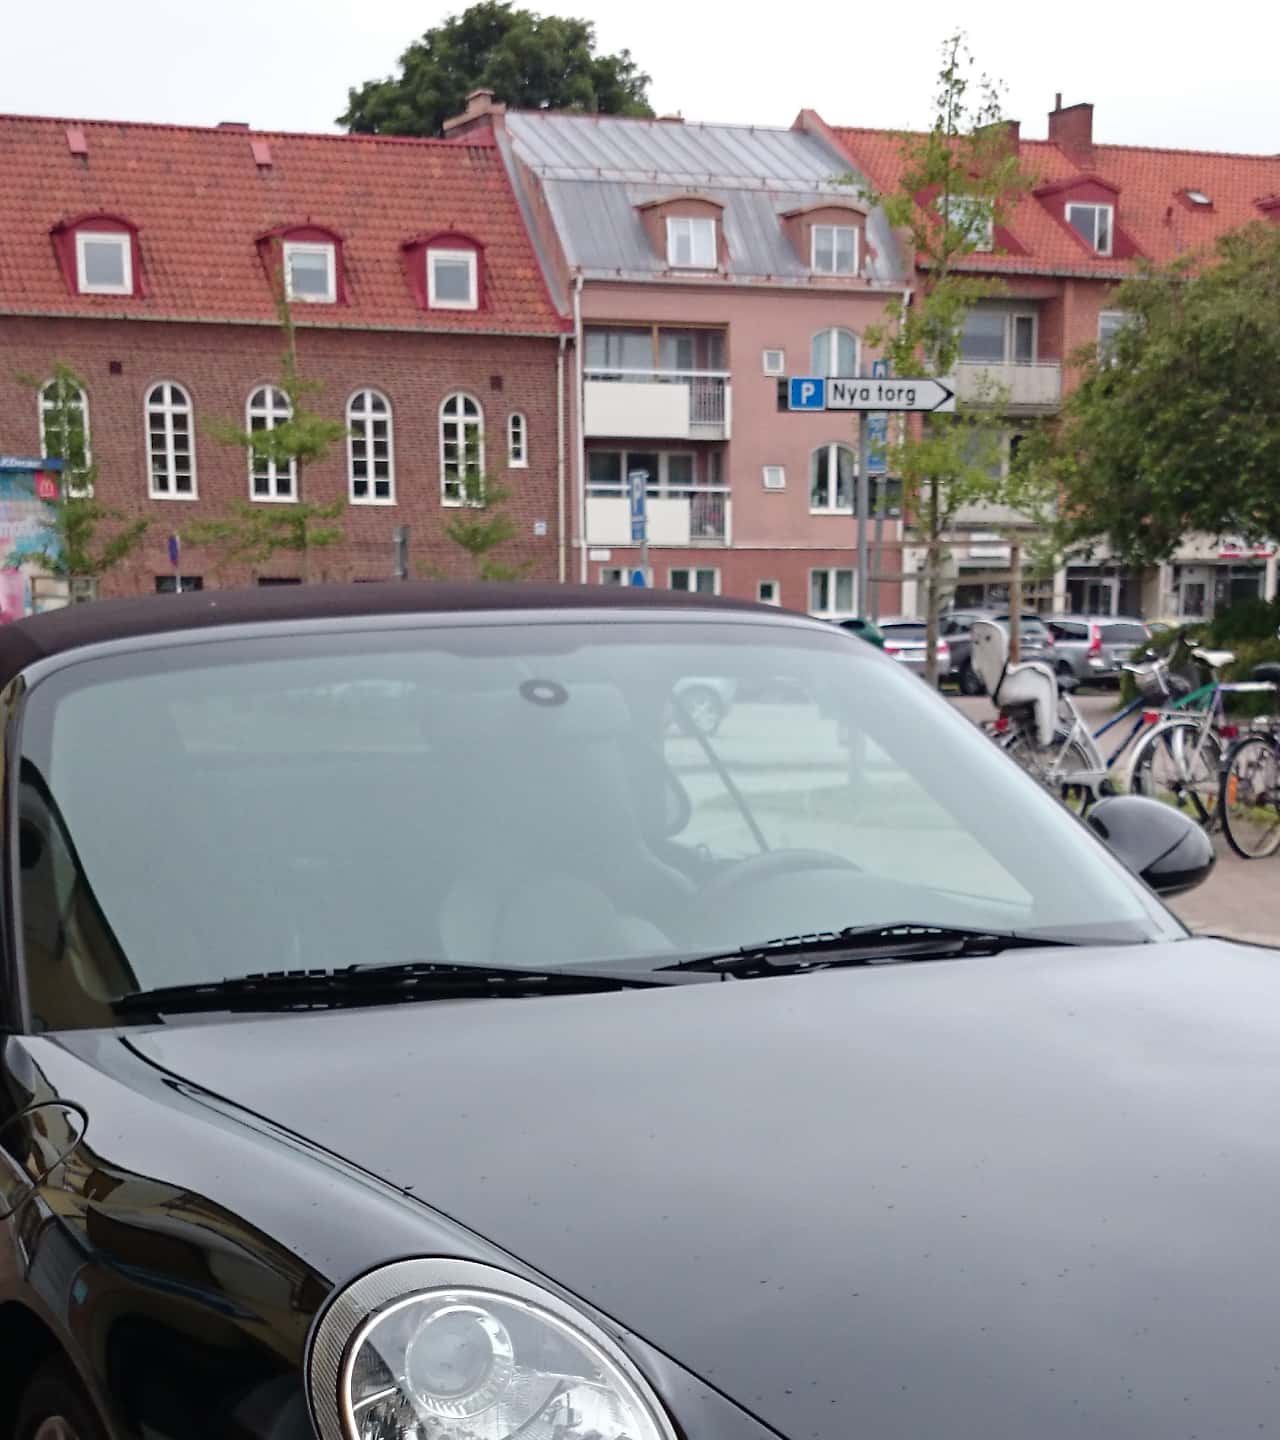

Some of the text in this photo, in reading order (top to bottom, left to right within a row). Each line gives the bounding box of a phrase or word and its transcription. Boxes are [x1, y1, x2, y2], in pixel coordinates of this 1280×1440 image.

[801, 383, 815, 404] P
[833, 383, 916, 406] Nya torg
